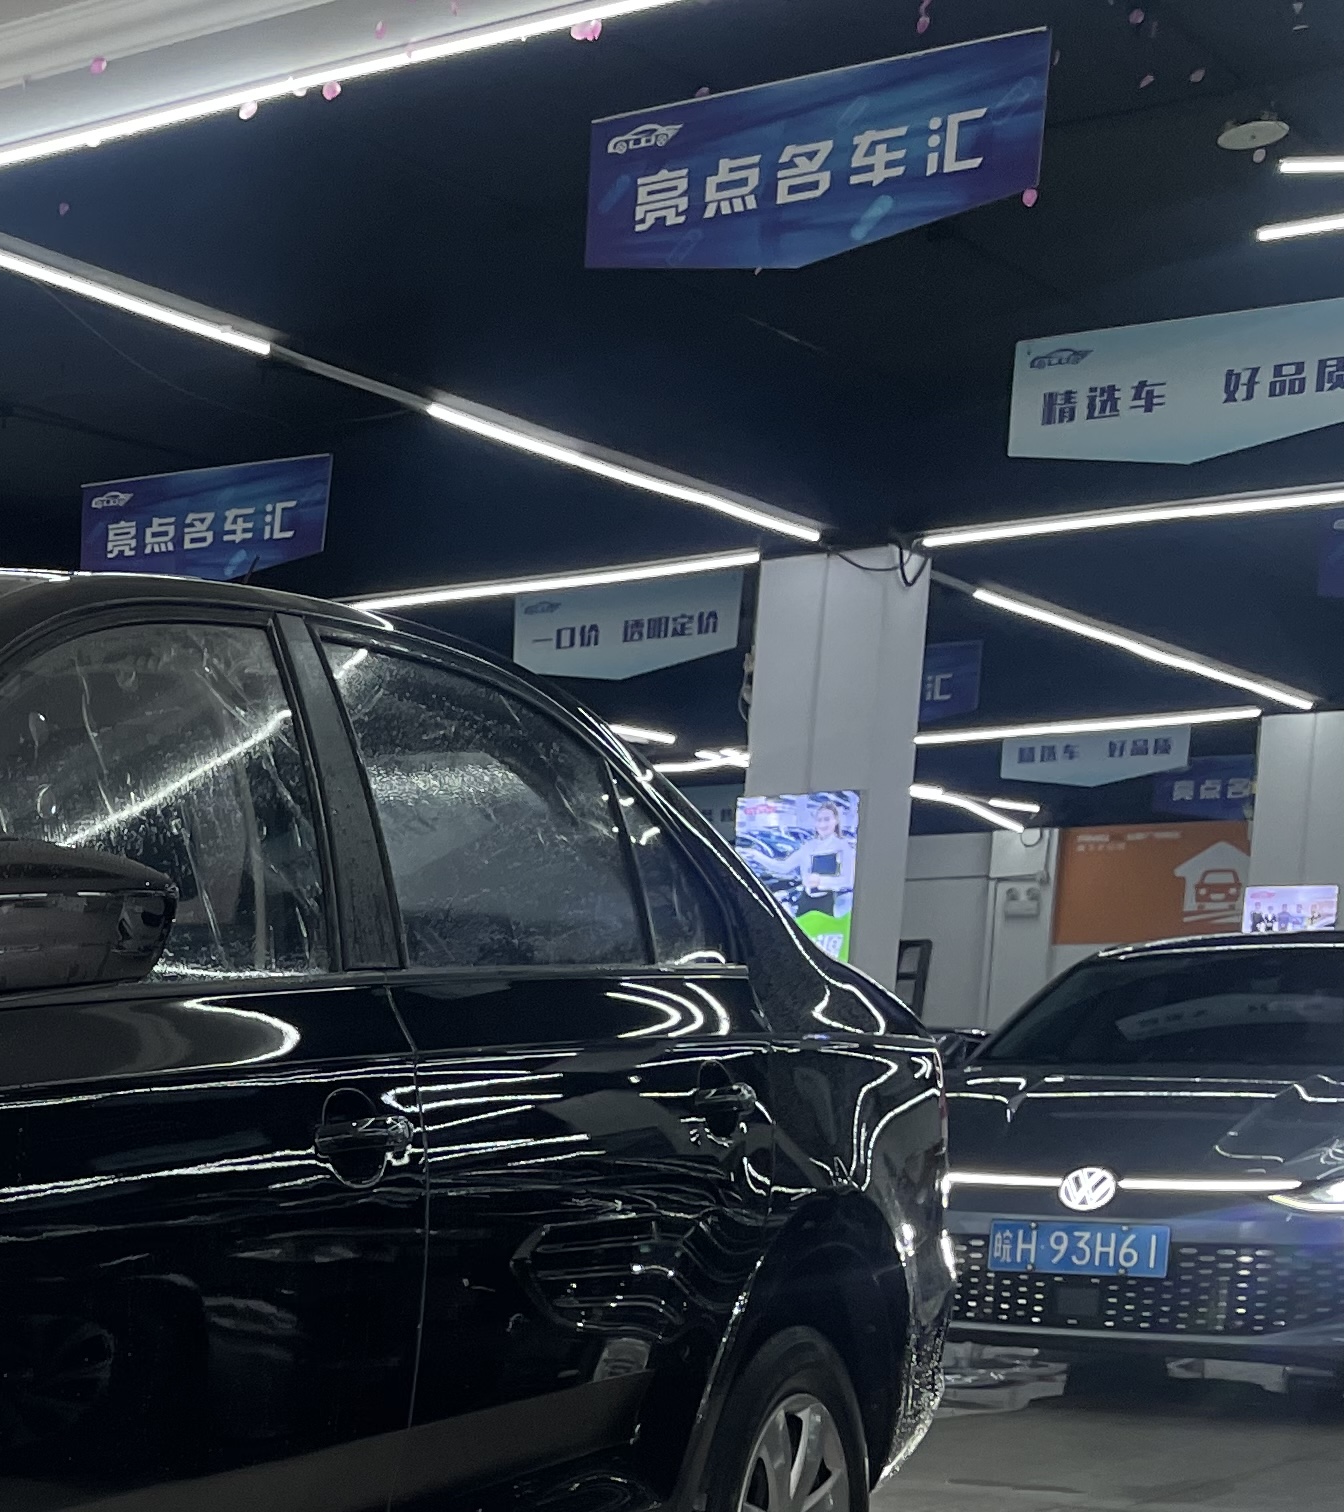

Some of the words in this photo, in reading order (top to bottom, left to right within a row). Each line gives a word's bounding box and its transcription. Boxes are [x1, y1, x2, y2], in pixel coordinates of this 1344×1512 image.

[635, 108, 988, 231] 亮点名车汇
[1041, 380, 1166, 425] 精选车
[107, 501, 297, 558] 亮点名车汇
[532, 624, 600, 649] 一口价
[623, 610, 718, 642] 透明定价
